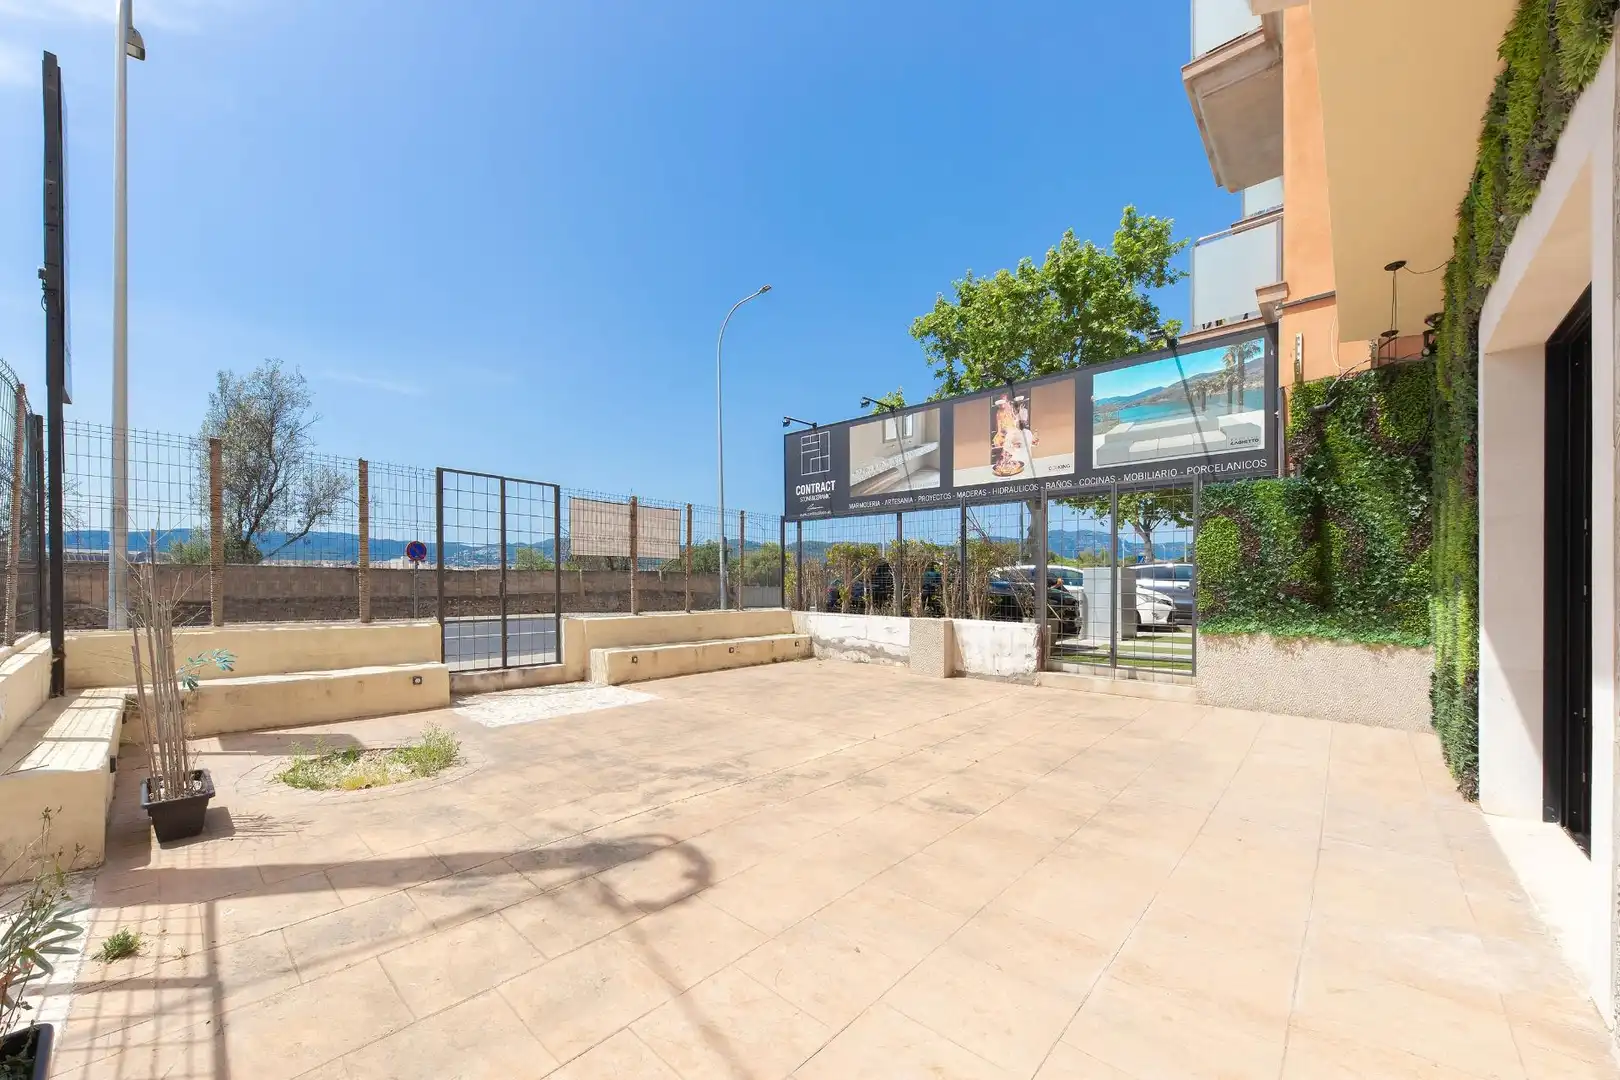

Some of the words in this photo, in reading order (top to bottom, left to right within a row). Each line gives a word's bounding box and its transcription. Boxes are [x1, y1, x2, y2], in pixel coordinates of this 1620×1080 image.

[795, 480, 836, 496] CONTRACT
[848, 500, 881, 510] MARMOLERIA
[884, 496, 914, 506] ARTESANIA
[918, 491, 952, 503] PROYECTOS
[956, 488, 987, 499] MADERAS
[992, 483, 1039, 495] HIDRAULICOS
[1045, 479, 1073, 490] BAÑOS
[1078, 475, 1116, 487] COCINAS
[1123, 468, 1178, 482] MOBILIARIO
[1186, 458, 1268, 476] PORCELANICOS
